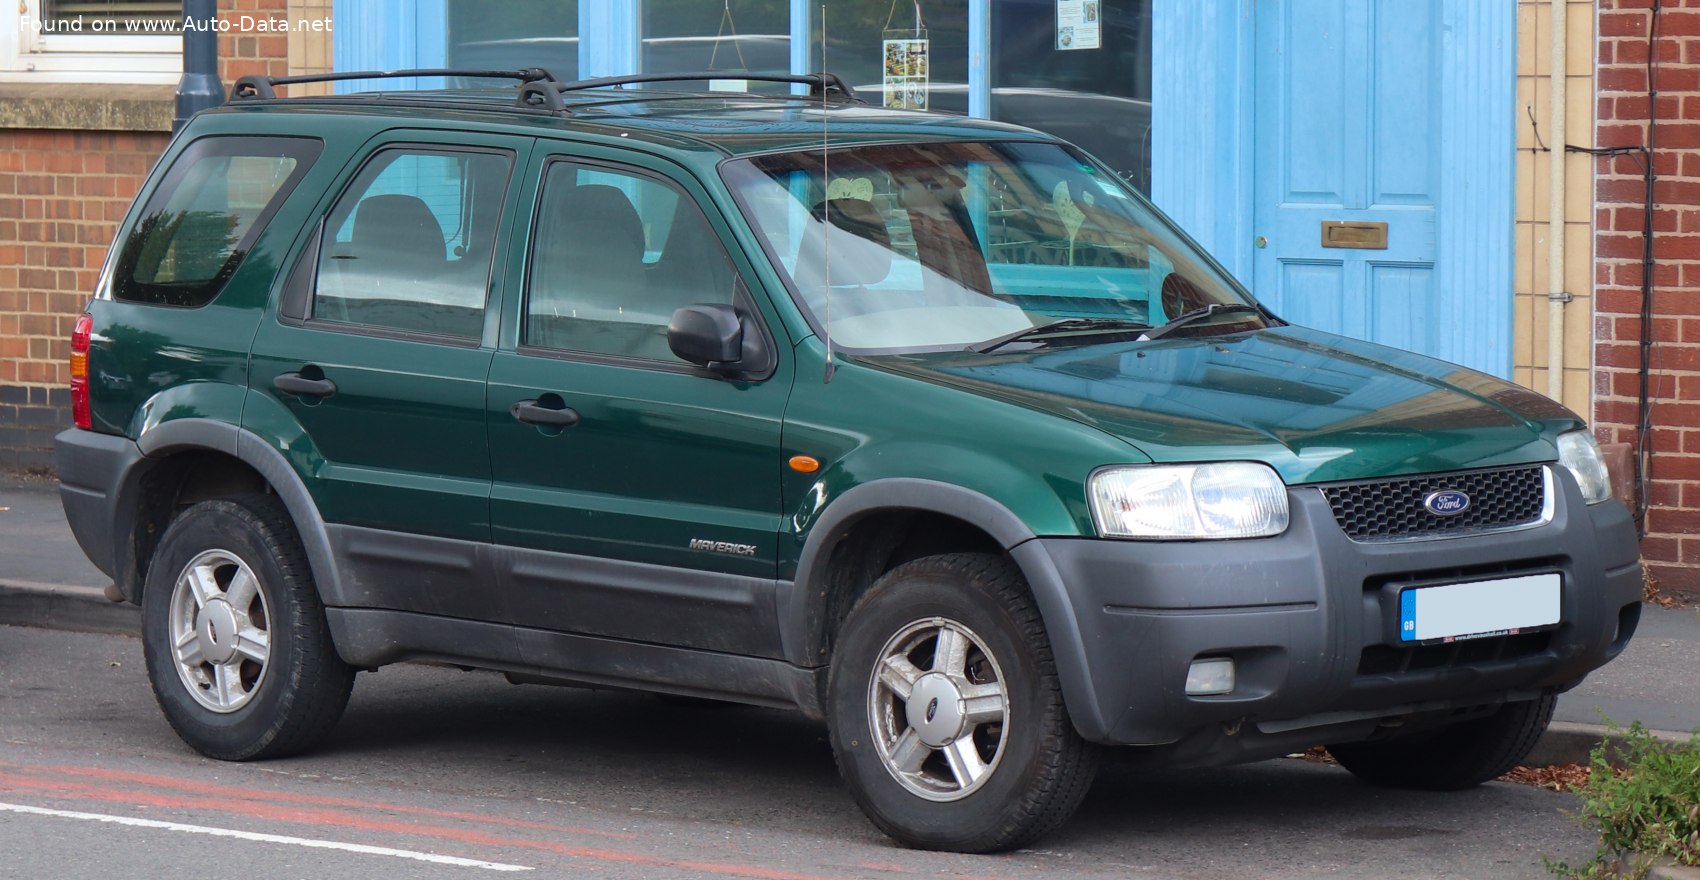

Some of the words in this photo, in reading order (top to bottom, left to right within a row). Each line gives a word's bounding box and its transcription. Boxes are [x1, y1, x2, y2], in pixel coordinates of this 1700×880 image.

[1437, 495, 1461, 510] Ford
[689, 538, 757, 556] MAVERICK
[1403, 620, 1415, 632] GB
